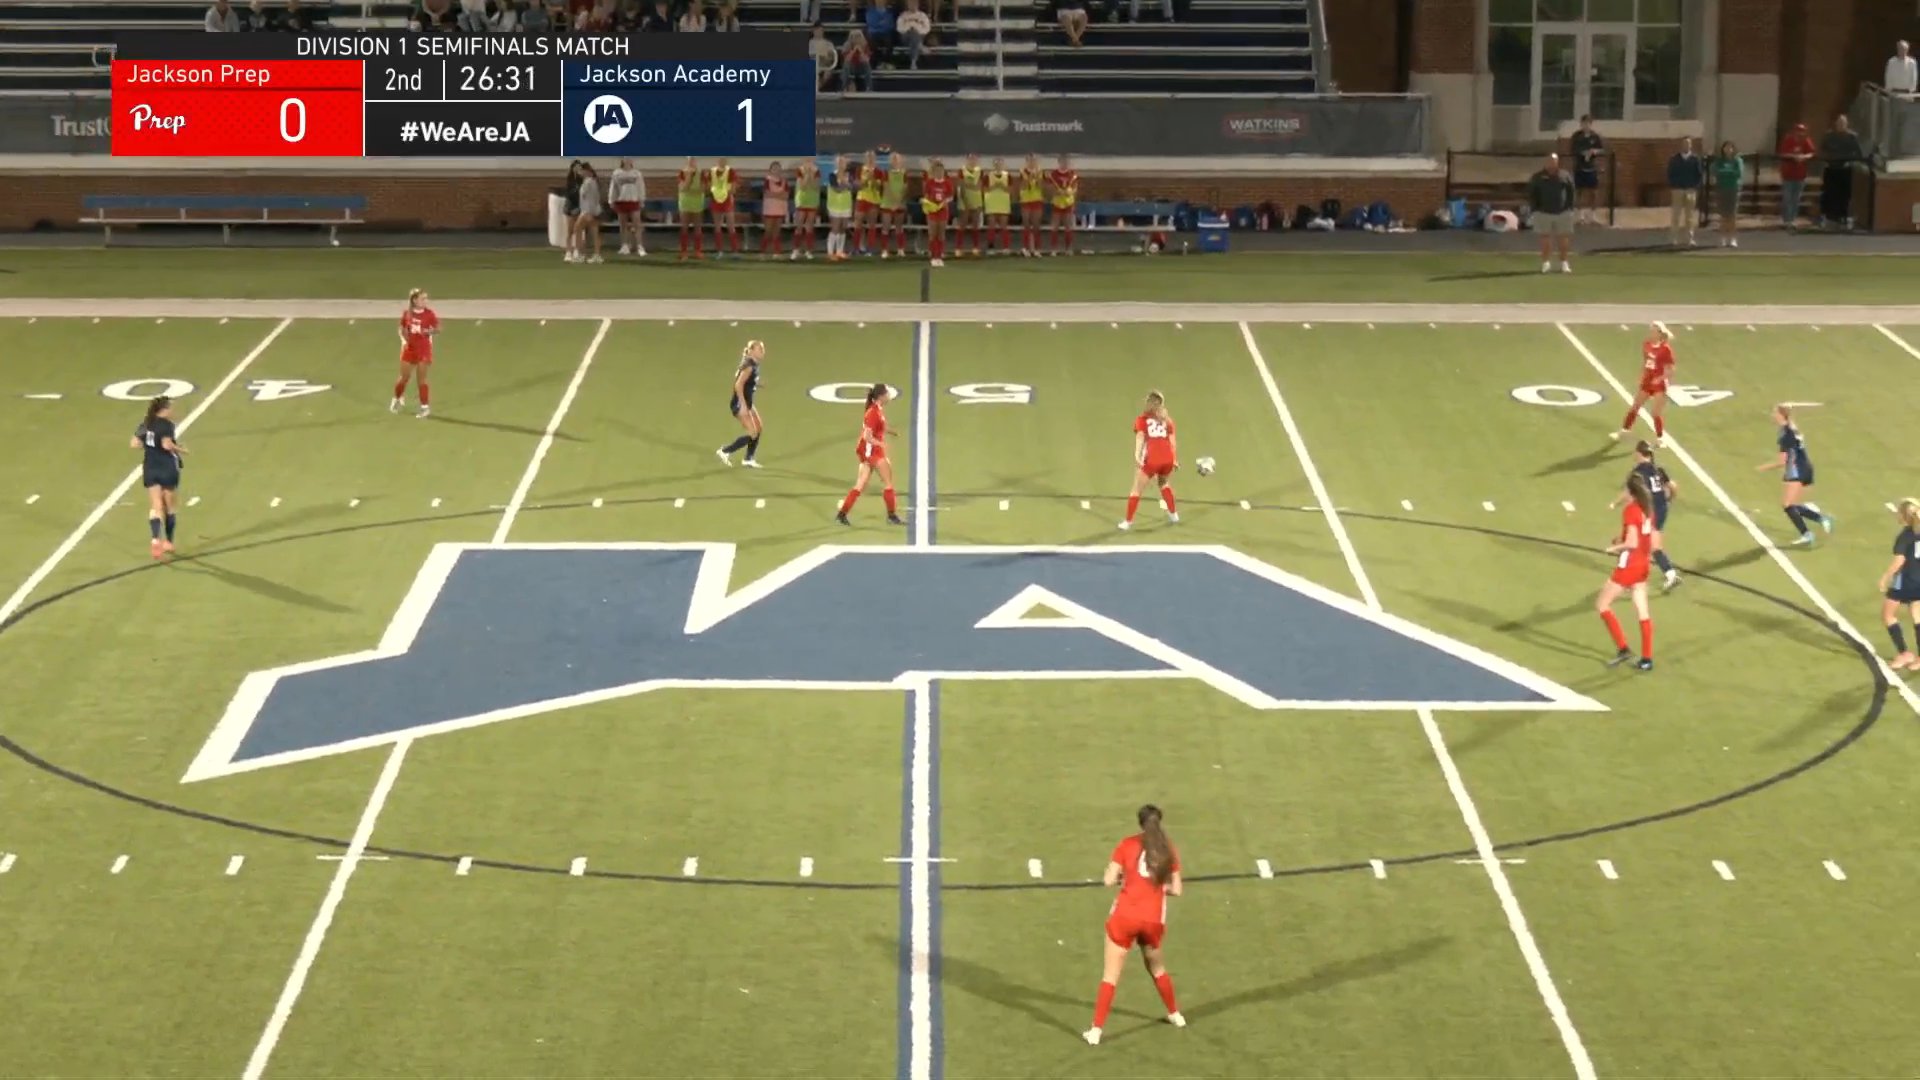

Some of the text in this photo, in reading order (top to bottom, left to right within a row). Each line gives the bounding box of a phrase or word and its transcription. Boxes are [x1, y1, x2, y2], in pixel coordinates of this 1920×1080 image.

[1012, 119, 1083, 132] Trustmark
[1228, 118, 1300, 130] WATKINS
[181, 541, 1609, 782] JA
